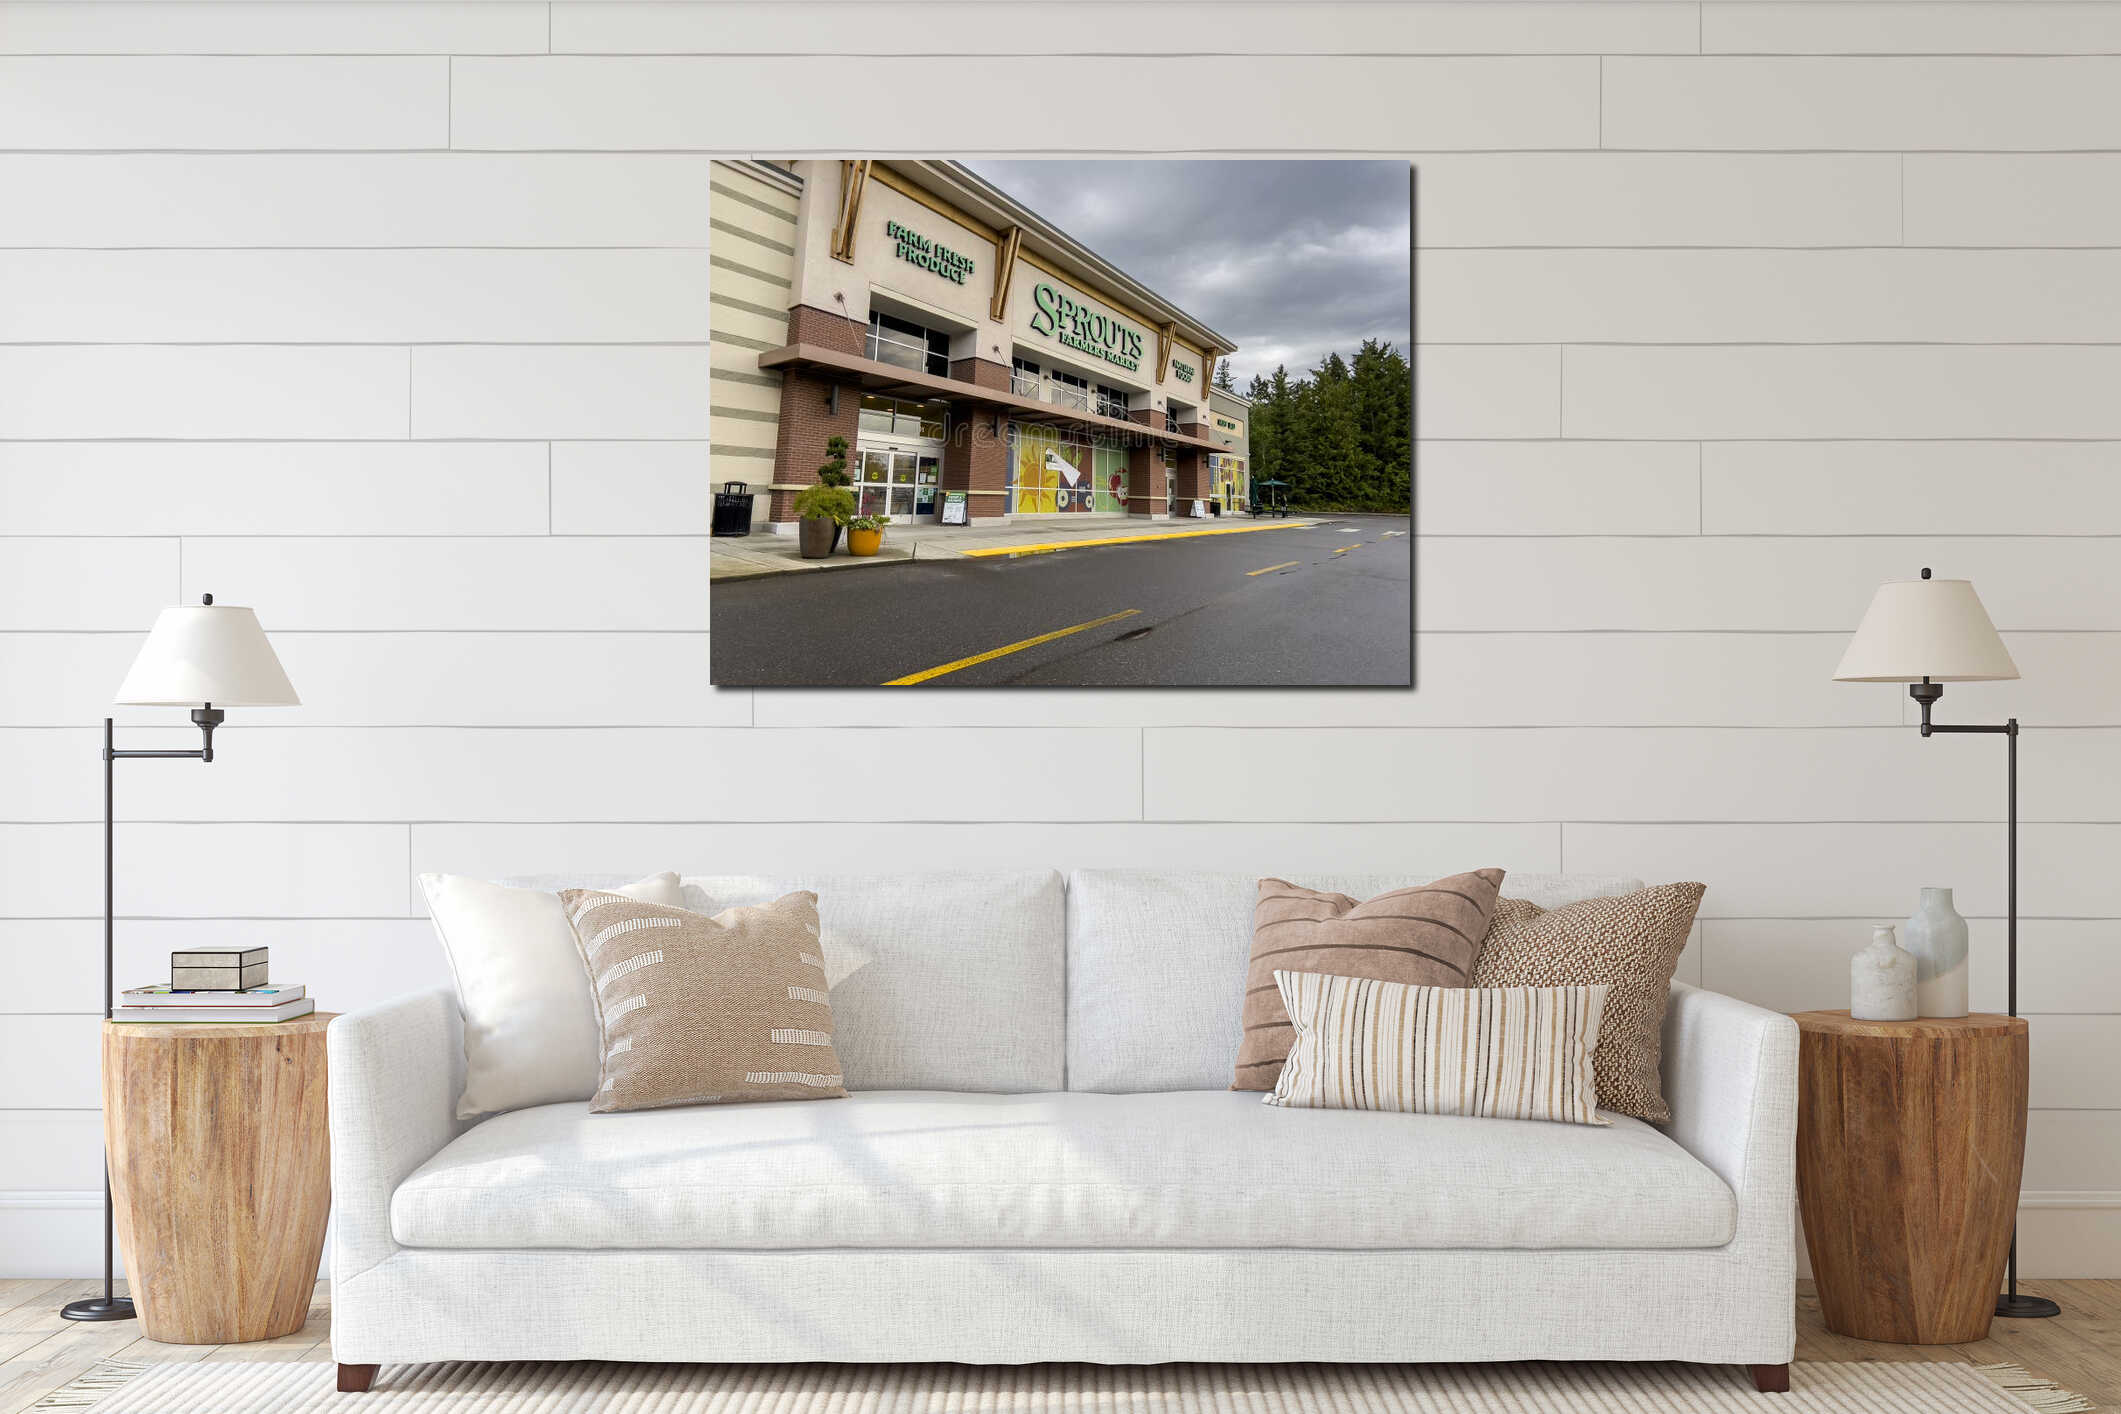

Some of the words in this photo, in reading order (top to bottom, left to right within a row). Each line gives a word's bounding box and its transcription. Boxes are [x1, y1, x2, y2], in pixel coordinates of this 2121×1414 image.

[887, 220, 932, 254] FARM
[934, 243, 975, 275] FRESH
[896, 242, 967, 285] PRODUCE
[1030, 282, 1145, 361] SPROUTS
[1059, 331, 1105, 359] FARMERS
